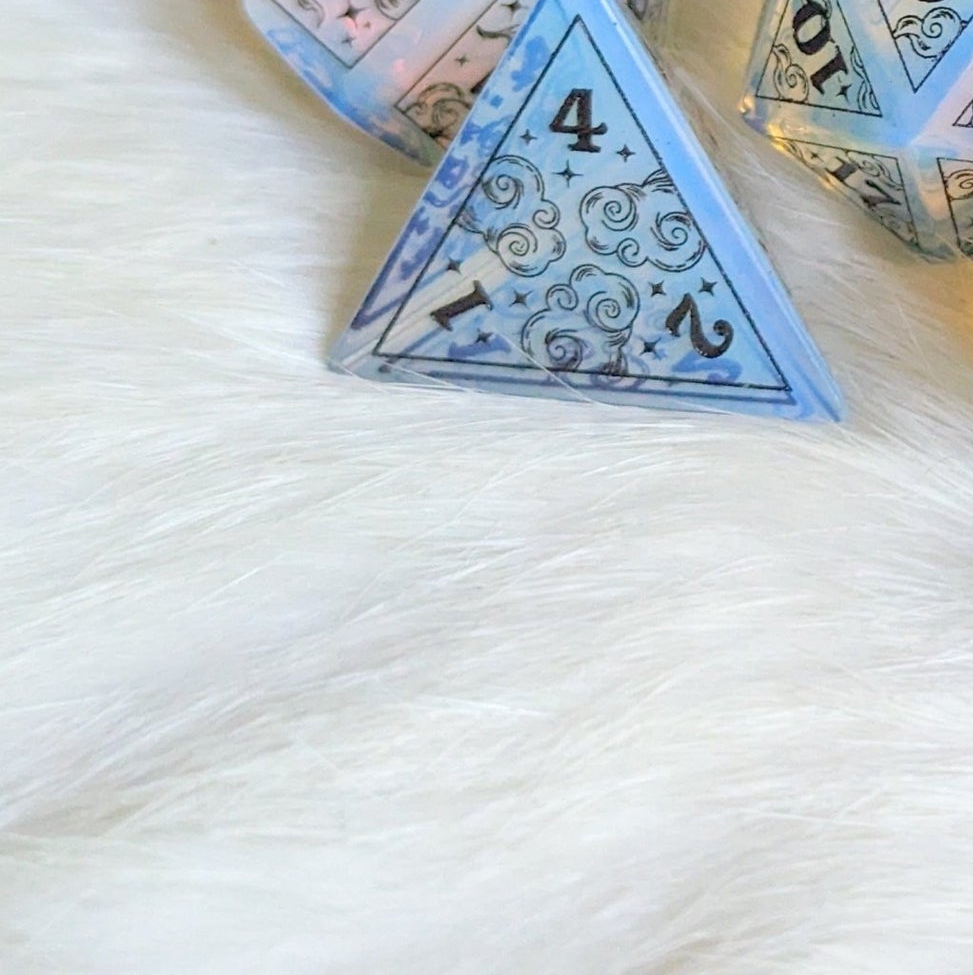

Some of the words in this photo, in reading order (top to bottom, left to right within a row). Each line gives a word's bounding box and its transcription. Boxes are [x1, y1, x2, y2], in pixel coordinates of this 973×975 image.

[549, 88, 607, 152] 4
[430, 279, 494, 331] 1
[665, 293, 733, 358] 2
